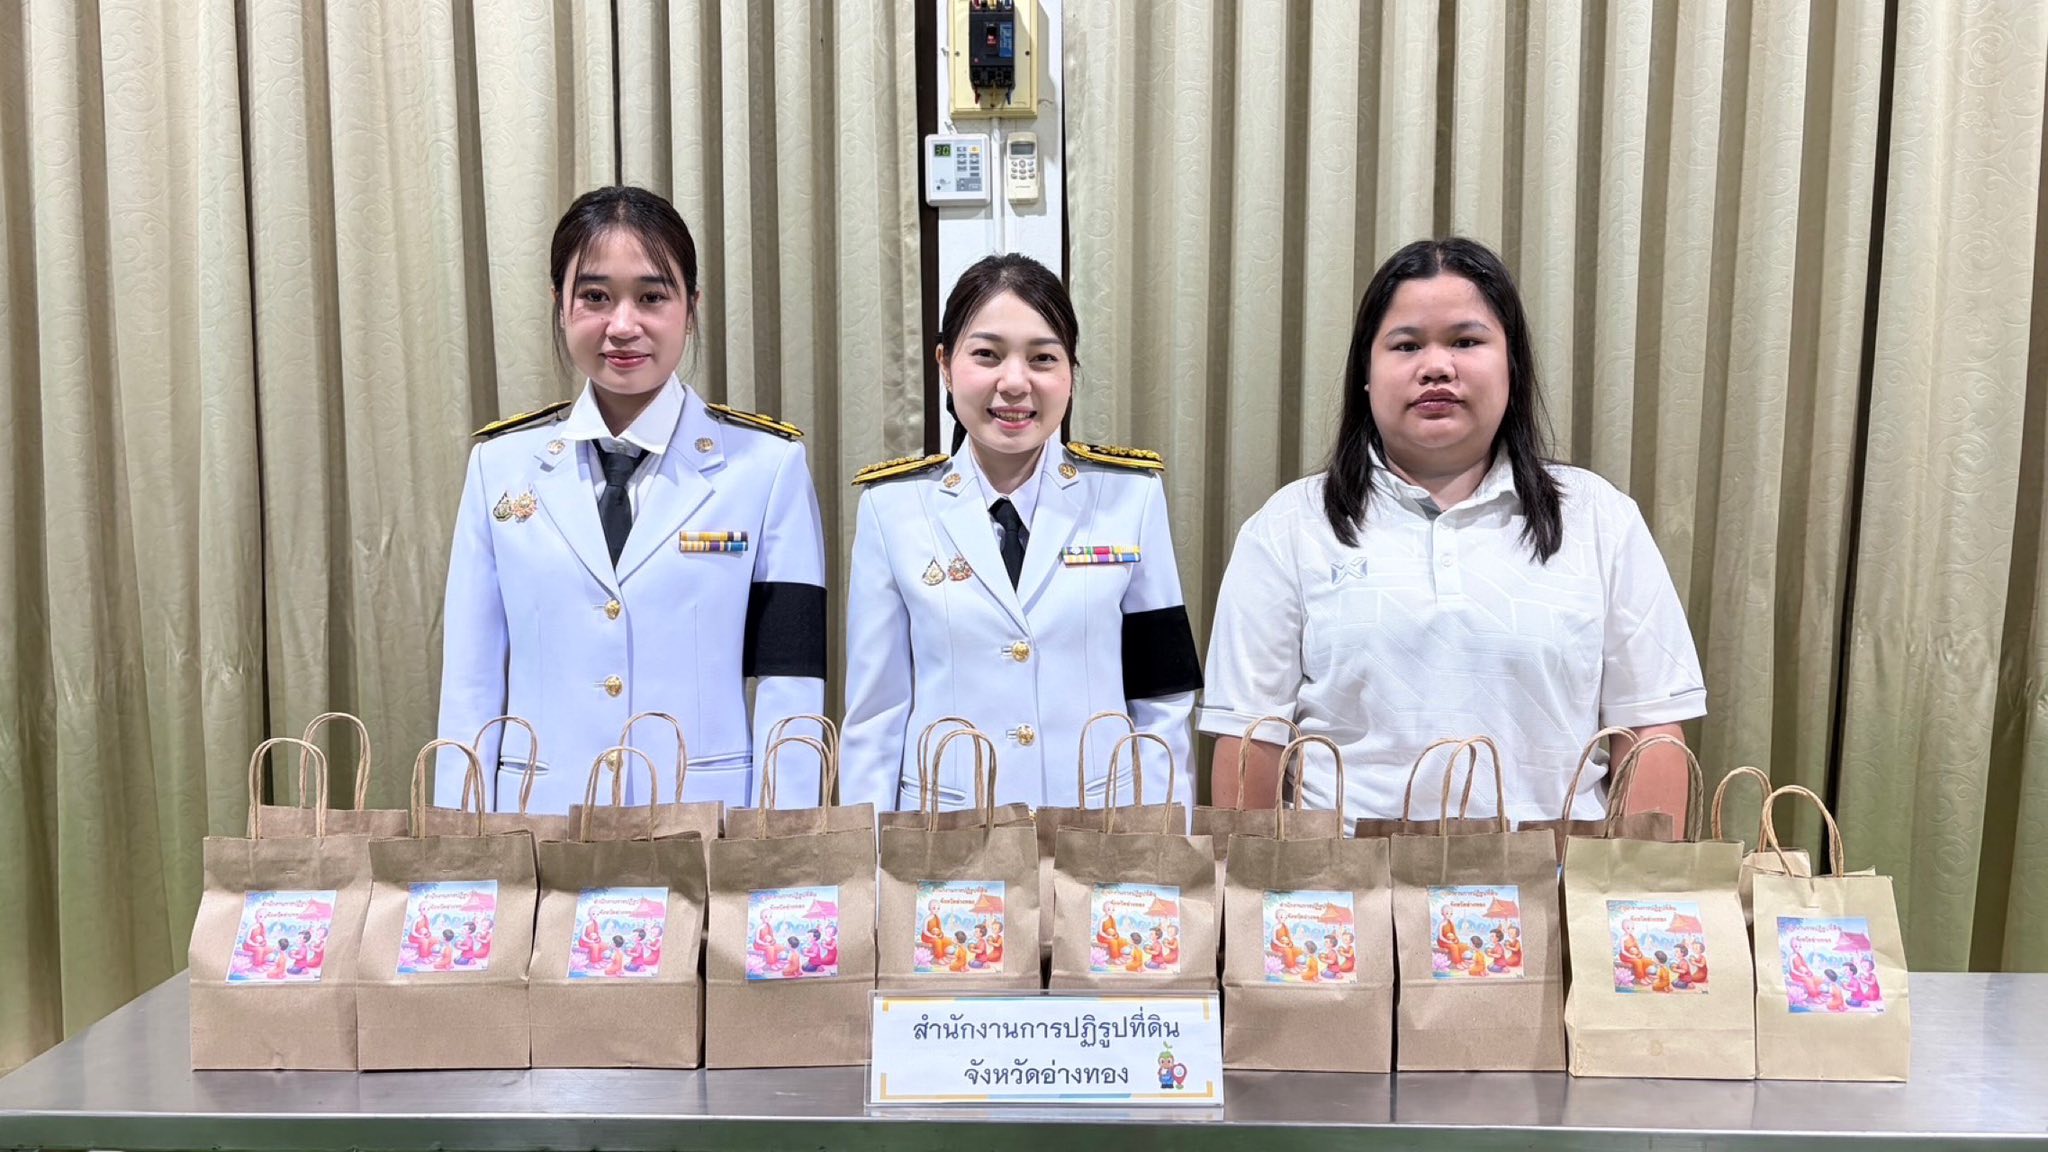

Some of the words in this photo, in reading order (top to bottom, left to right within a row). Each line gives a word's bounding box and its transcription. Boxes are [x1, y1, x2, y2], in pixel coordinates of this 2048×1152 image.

[913, 1006, 1180, 1049] สำนักงานการปฏิรูปที่ดิน
[964, 1058, 1129, 1085] จังหวัดอ่างทอง
